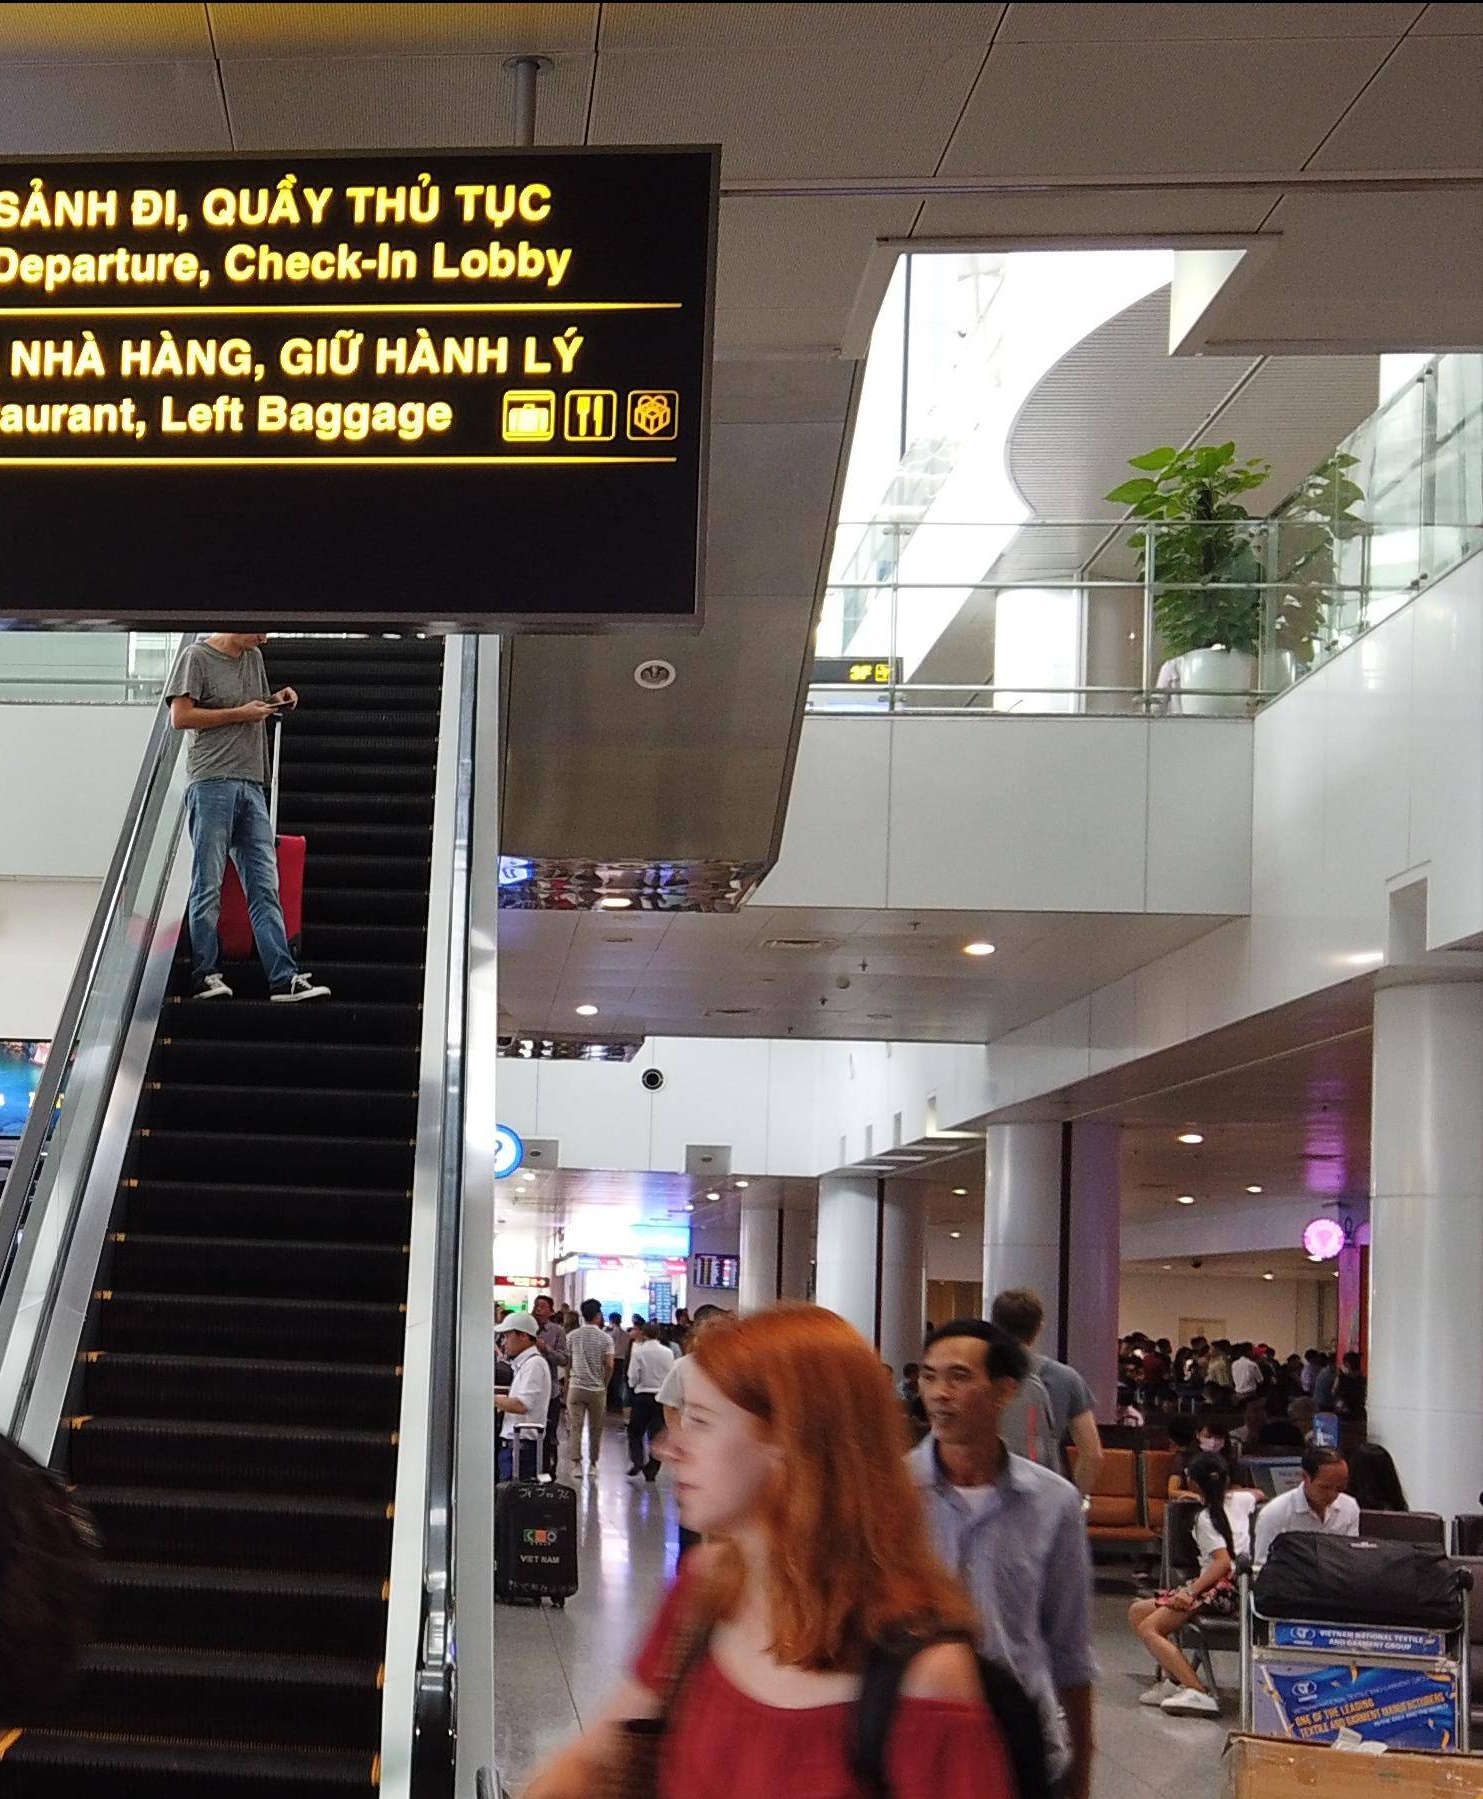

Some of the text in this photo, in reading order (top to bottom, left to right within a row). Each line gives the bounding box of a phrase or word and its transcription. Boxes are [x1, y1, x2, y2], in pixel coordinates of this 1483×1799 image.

[131, 190, 187, 232] ĐI,
[203, 174, 333, 227] QUẦY
[346, 173, 439, 224] THỦ
[455, 184, 551, 228] TỤC
[225, 243, 417, 282] Check-In
[433, 241, 572, 286] Lobby
[11, 331, 105, 378] NHÀ
[121, 331, 264, 381] HÀNG,
[280, 329, 364, 376] GIỮ
[376, 328, 508, 375] HÀNH
[524, 327, 583, 374] LÝ
[162, 396, 244, 434] Left
[258, 396, 453, 441] Baggage
